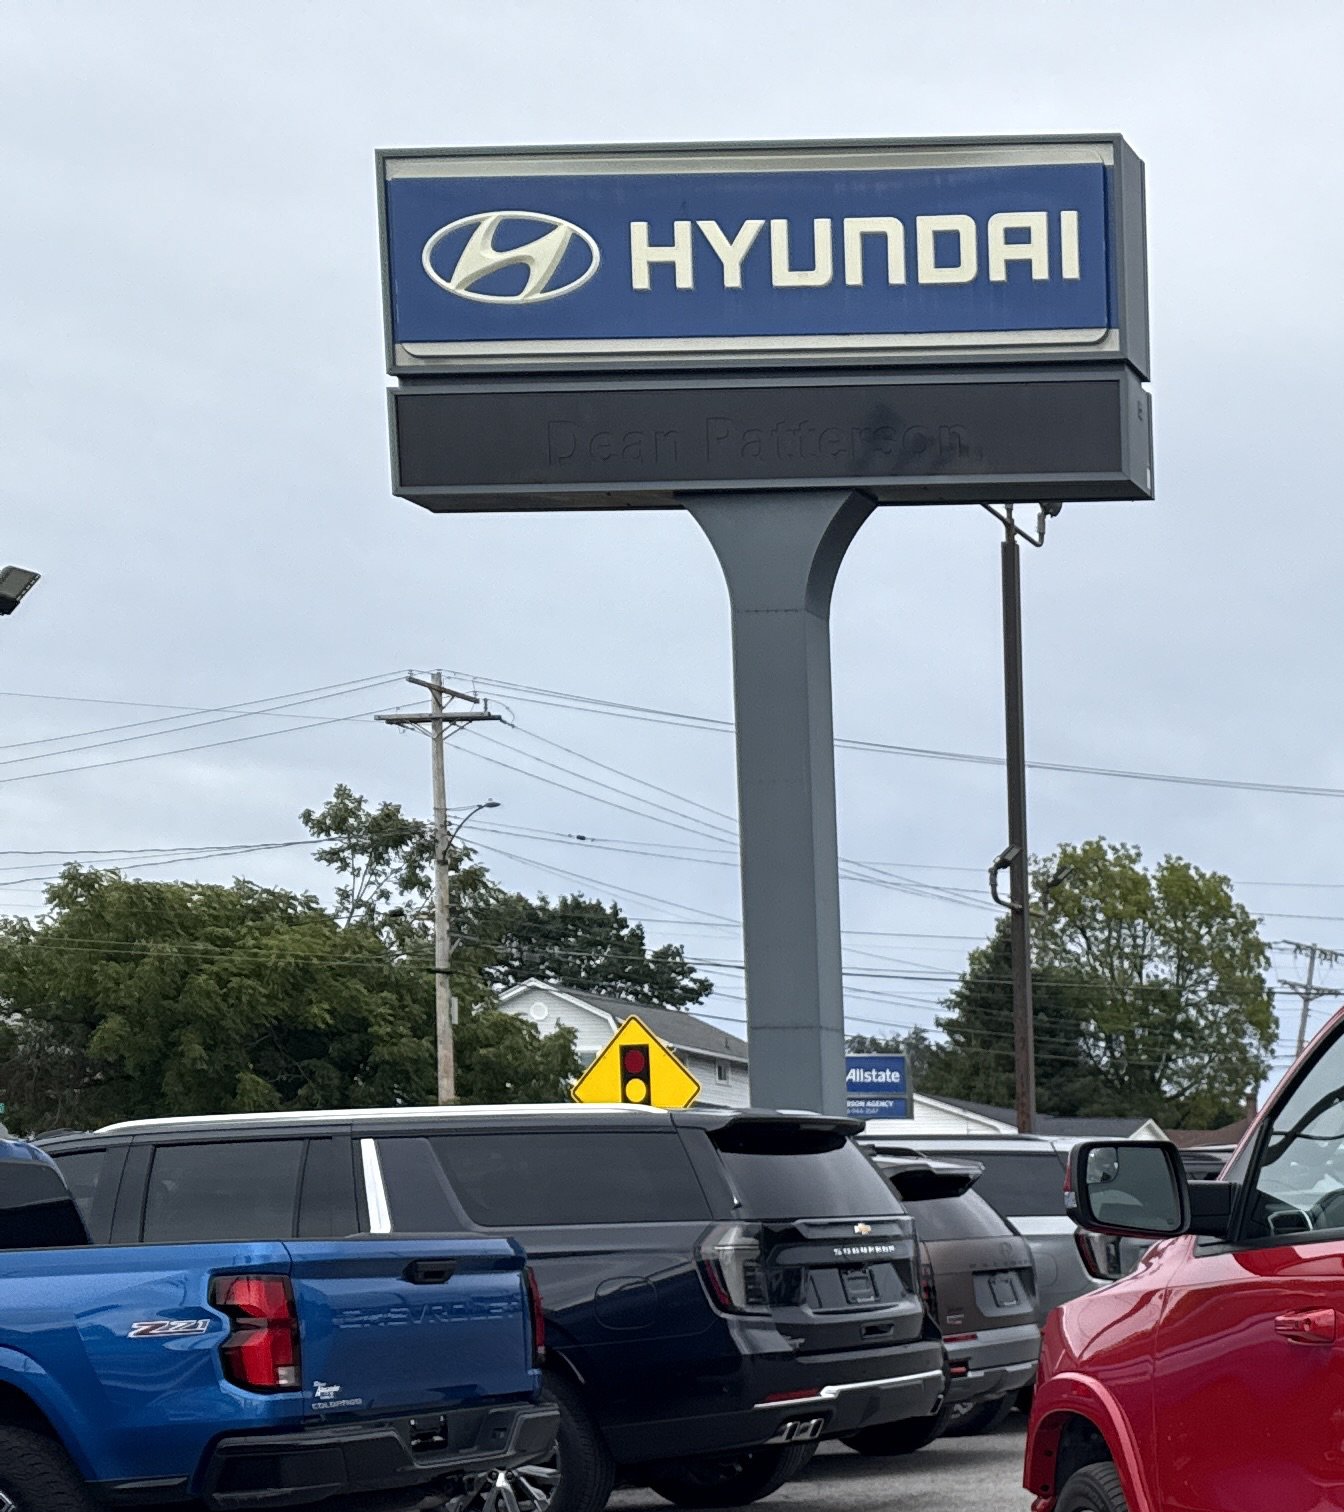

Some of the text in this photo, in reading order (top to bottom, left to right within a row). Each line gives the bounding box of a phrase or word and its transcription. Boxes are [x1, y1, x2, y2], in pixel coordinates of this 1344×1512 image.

[630, 210, 1079, 290] HYUNDAI
[546, 419, 680, 468] Dean
[845, 1067, 900, 1083] Allstate
